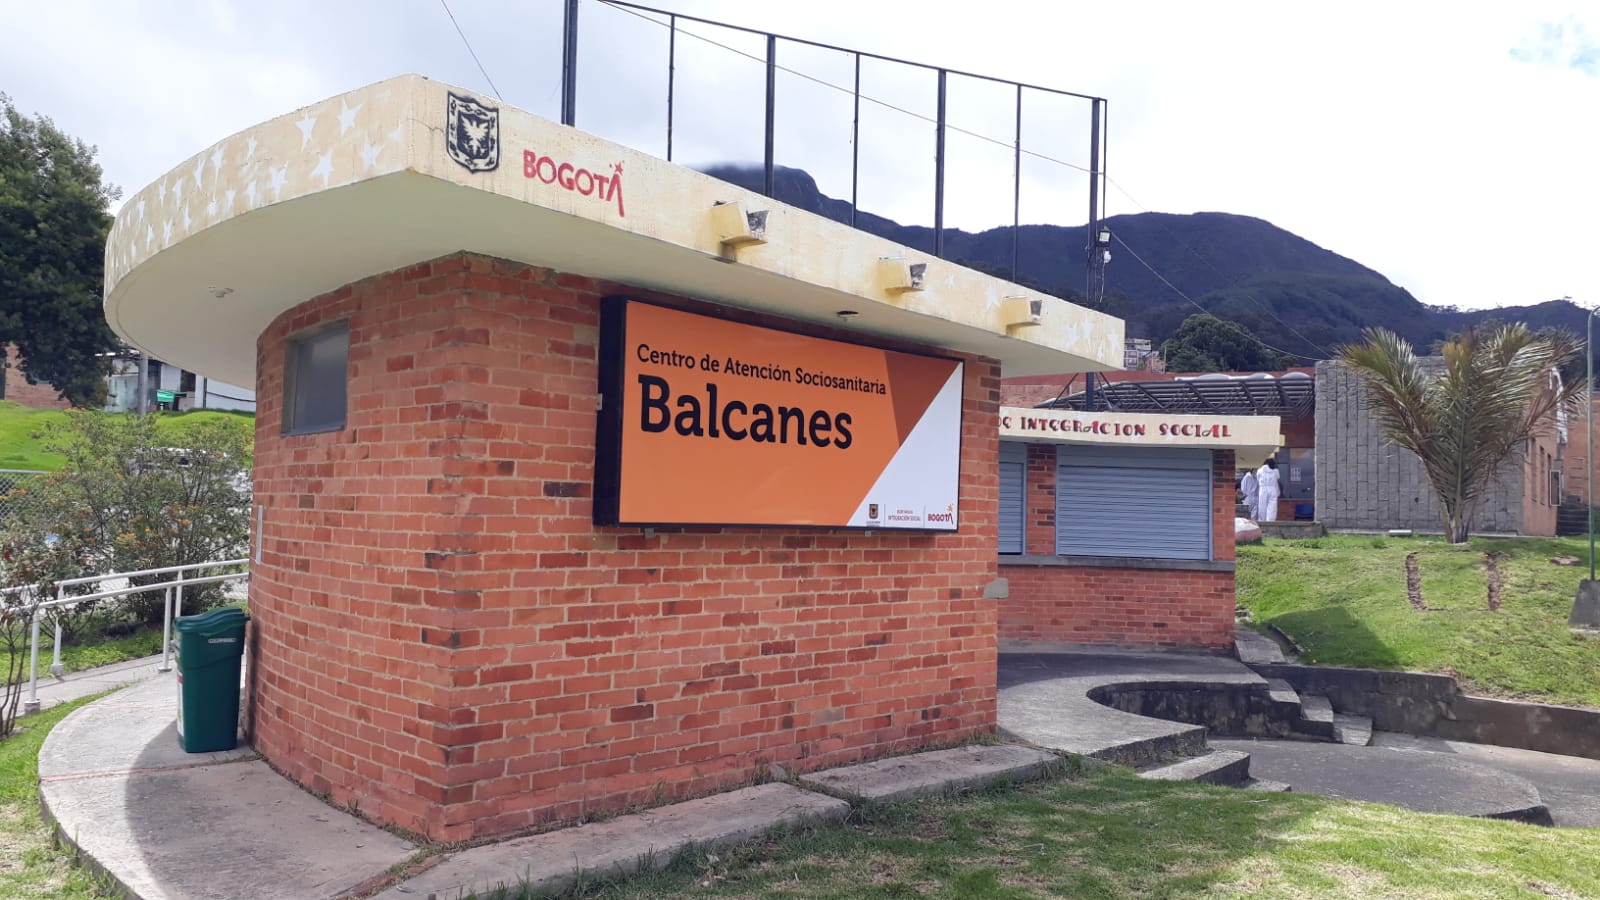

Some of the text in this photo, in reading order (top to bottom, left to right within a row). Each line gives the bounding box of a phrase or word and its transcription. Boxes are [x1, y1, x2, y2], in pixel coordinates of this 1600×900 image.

[523, 150, 624, 217] BOGOTÁ
[637, 343, 887, 395] Centro de Atención Sociosanitaria
[638, 374, 852, 449] Balcanes
[1020, 415, 1146, 436] INTEGRACION
[1159, 423, 1232, 438] SOCIAL
